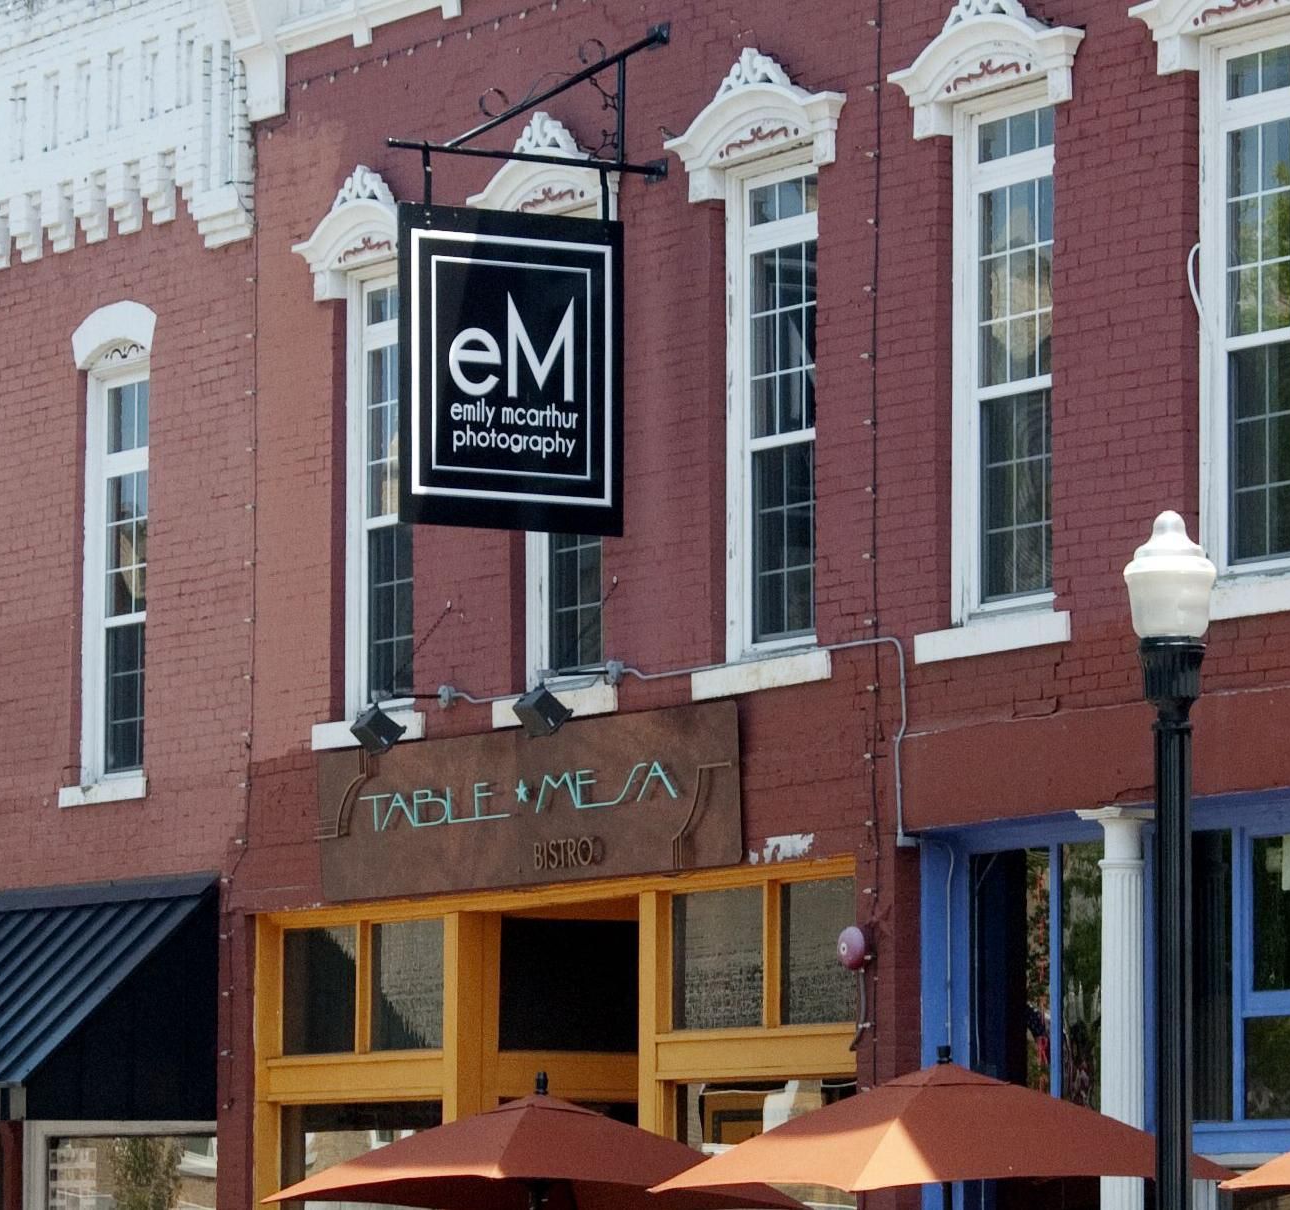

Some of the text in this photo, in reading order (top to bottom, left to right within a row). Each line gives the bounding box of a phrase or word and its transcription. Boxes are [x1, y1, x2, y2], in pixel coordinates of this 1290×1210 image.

[449, 290, 575, 402] eM
[450, 398, 579, 430] emily mcarthur
[452, 424, 577, 459] photography
[359, 761, 677, 832] TABLE MESA
[533, 837, 594, 870] BISTRO
